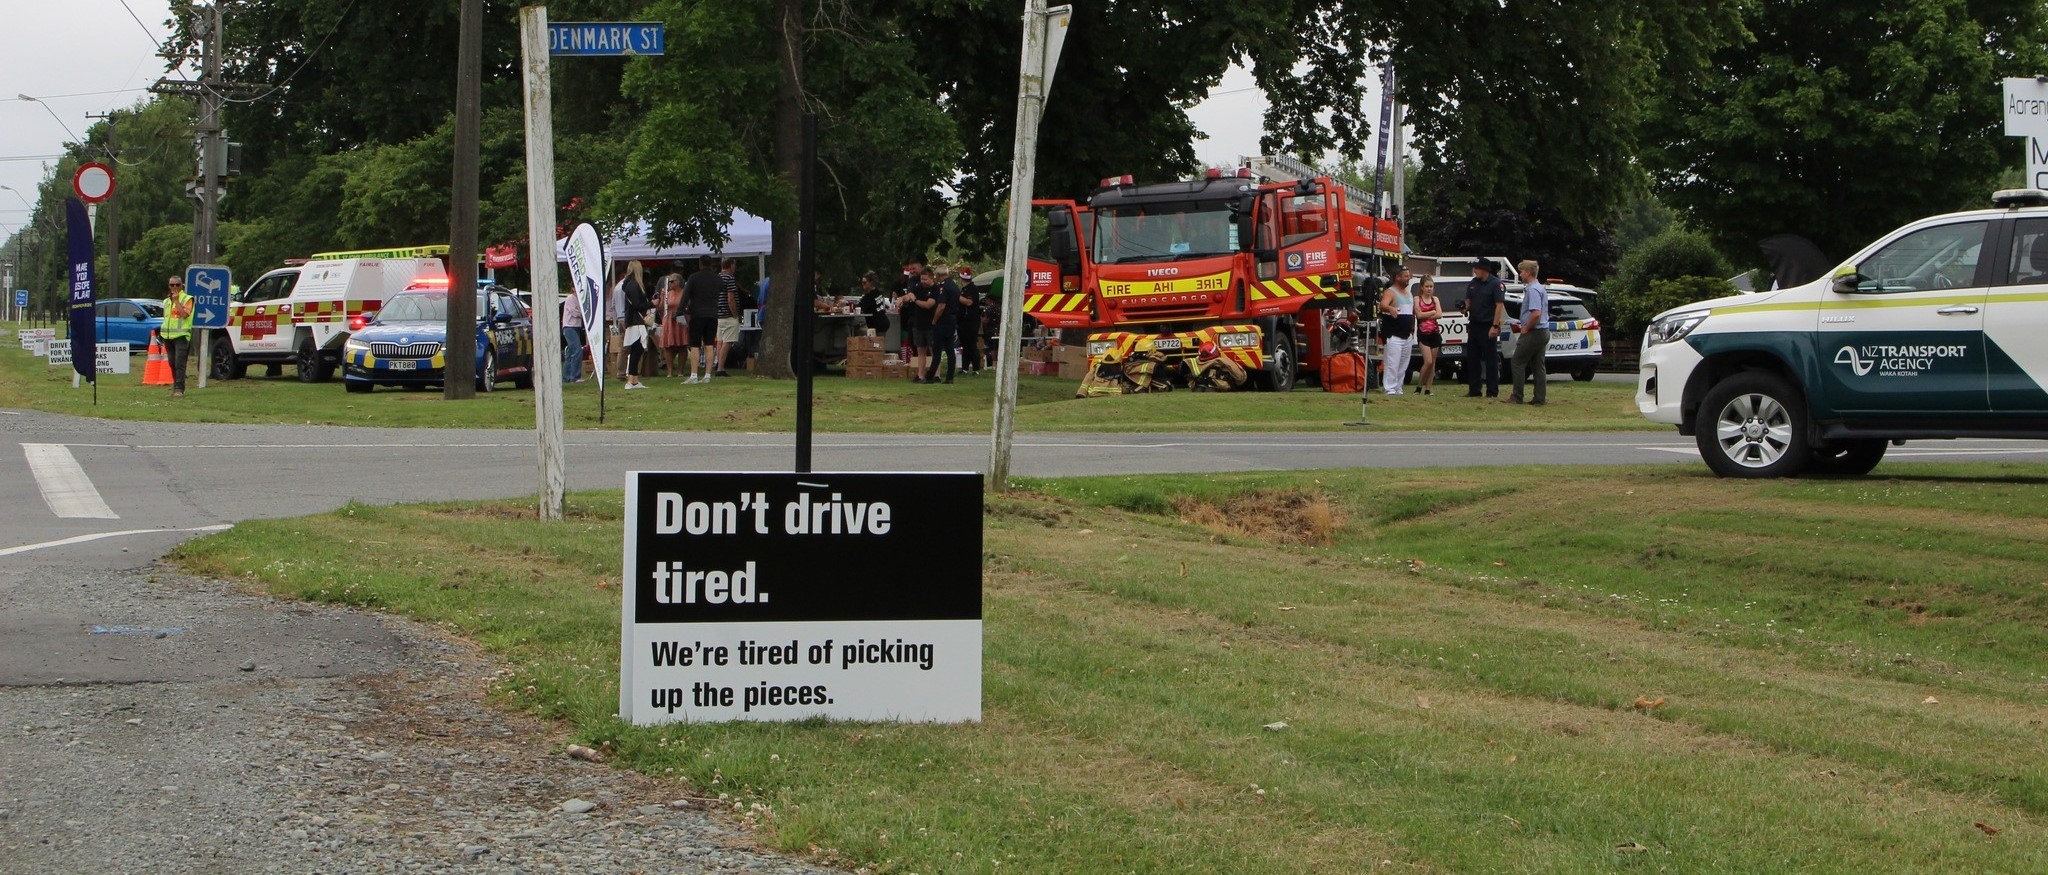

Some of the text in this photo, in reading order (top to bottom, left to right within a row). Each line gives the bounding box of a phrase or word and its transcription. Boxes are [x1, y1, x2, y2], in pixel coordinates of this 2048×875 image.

[548, 27, 659, 50] DENMARK ST
[2008, 93, 2048, 116] Aoran
[574, 238, 586, 276] ROAD
[1305, 251, 1327, 260] FIRE
[567, 245, 584, 294] SAFETY
[1033, 271, 1052, 280] FIRE
[1147, 267, 1178, 276] IVECO
[1106, 282, 1174, 295] FIRE AHI
[1121, 294, 1208, 305] EUROCARGO
[245, 320, 273, 328] FIRE RESCUE
[1438, 323, 1469, 335] OYOT
[1549, 343, 1578, 351] POLICE
[389, 361, 416, 369] PKT800
[1880, 358, 1934, 370] AGENCY
[656, 492, 891, 535] Don't drive
[652, 560, 769, 604] tired.
[651, 638, 934, 671] We're tired of picking
[651, 681, 834, 714] up the pieces.
